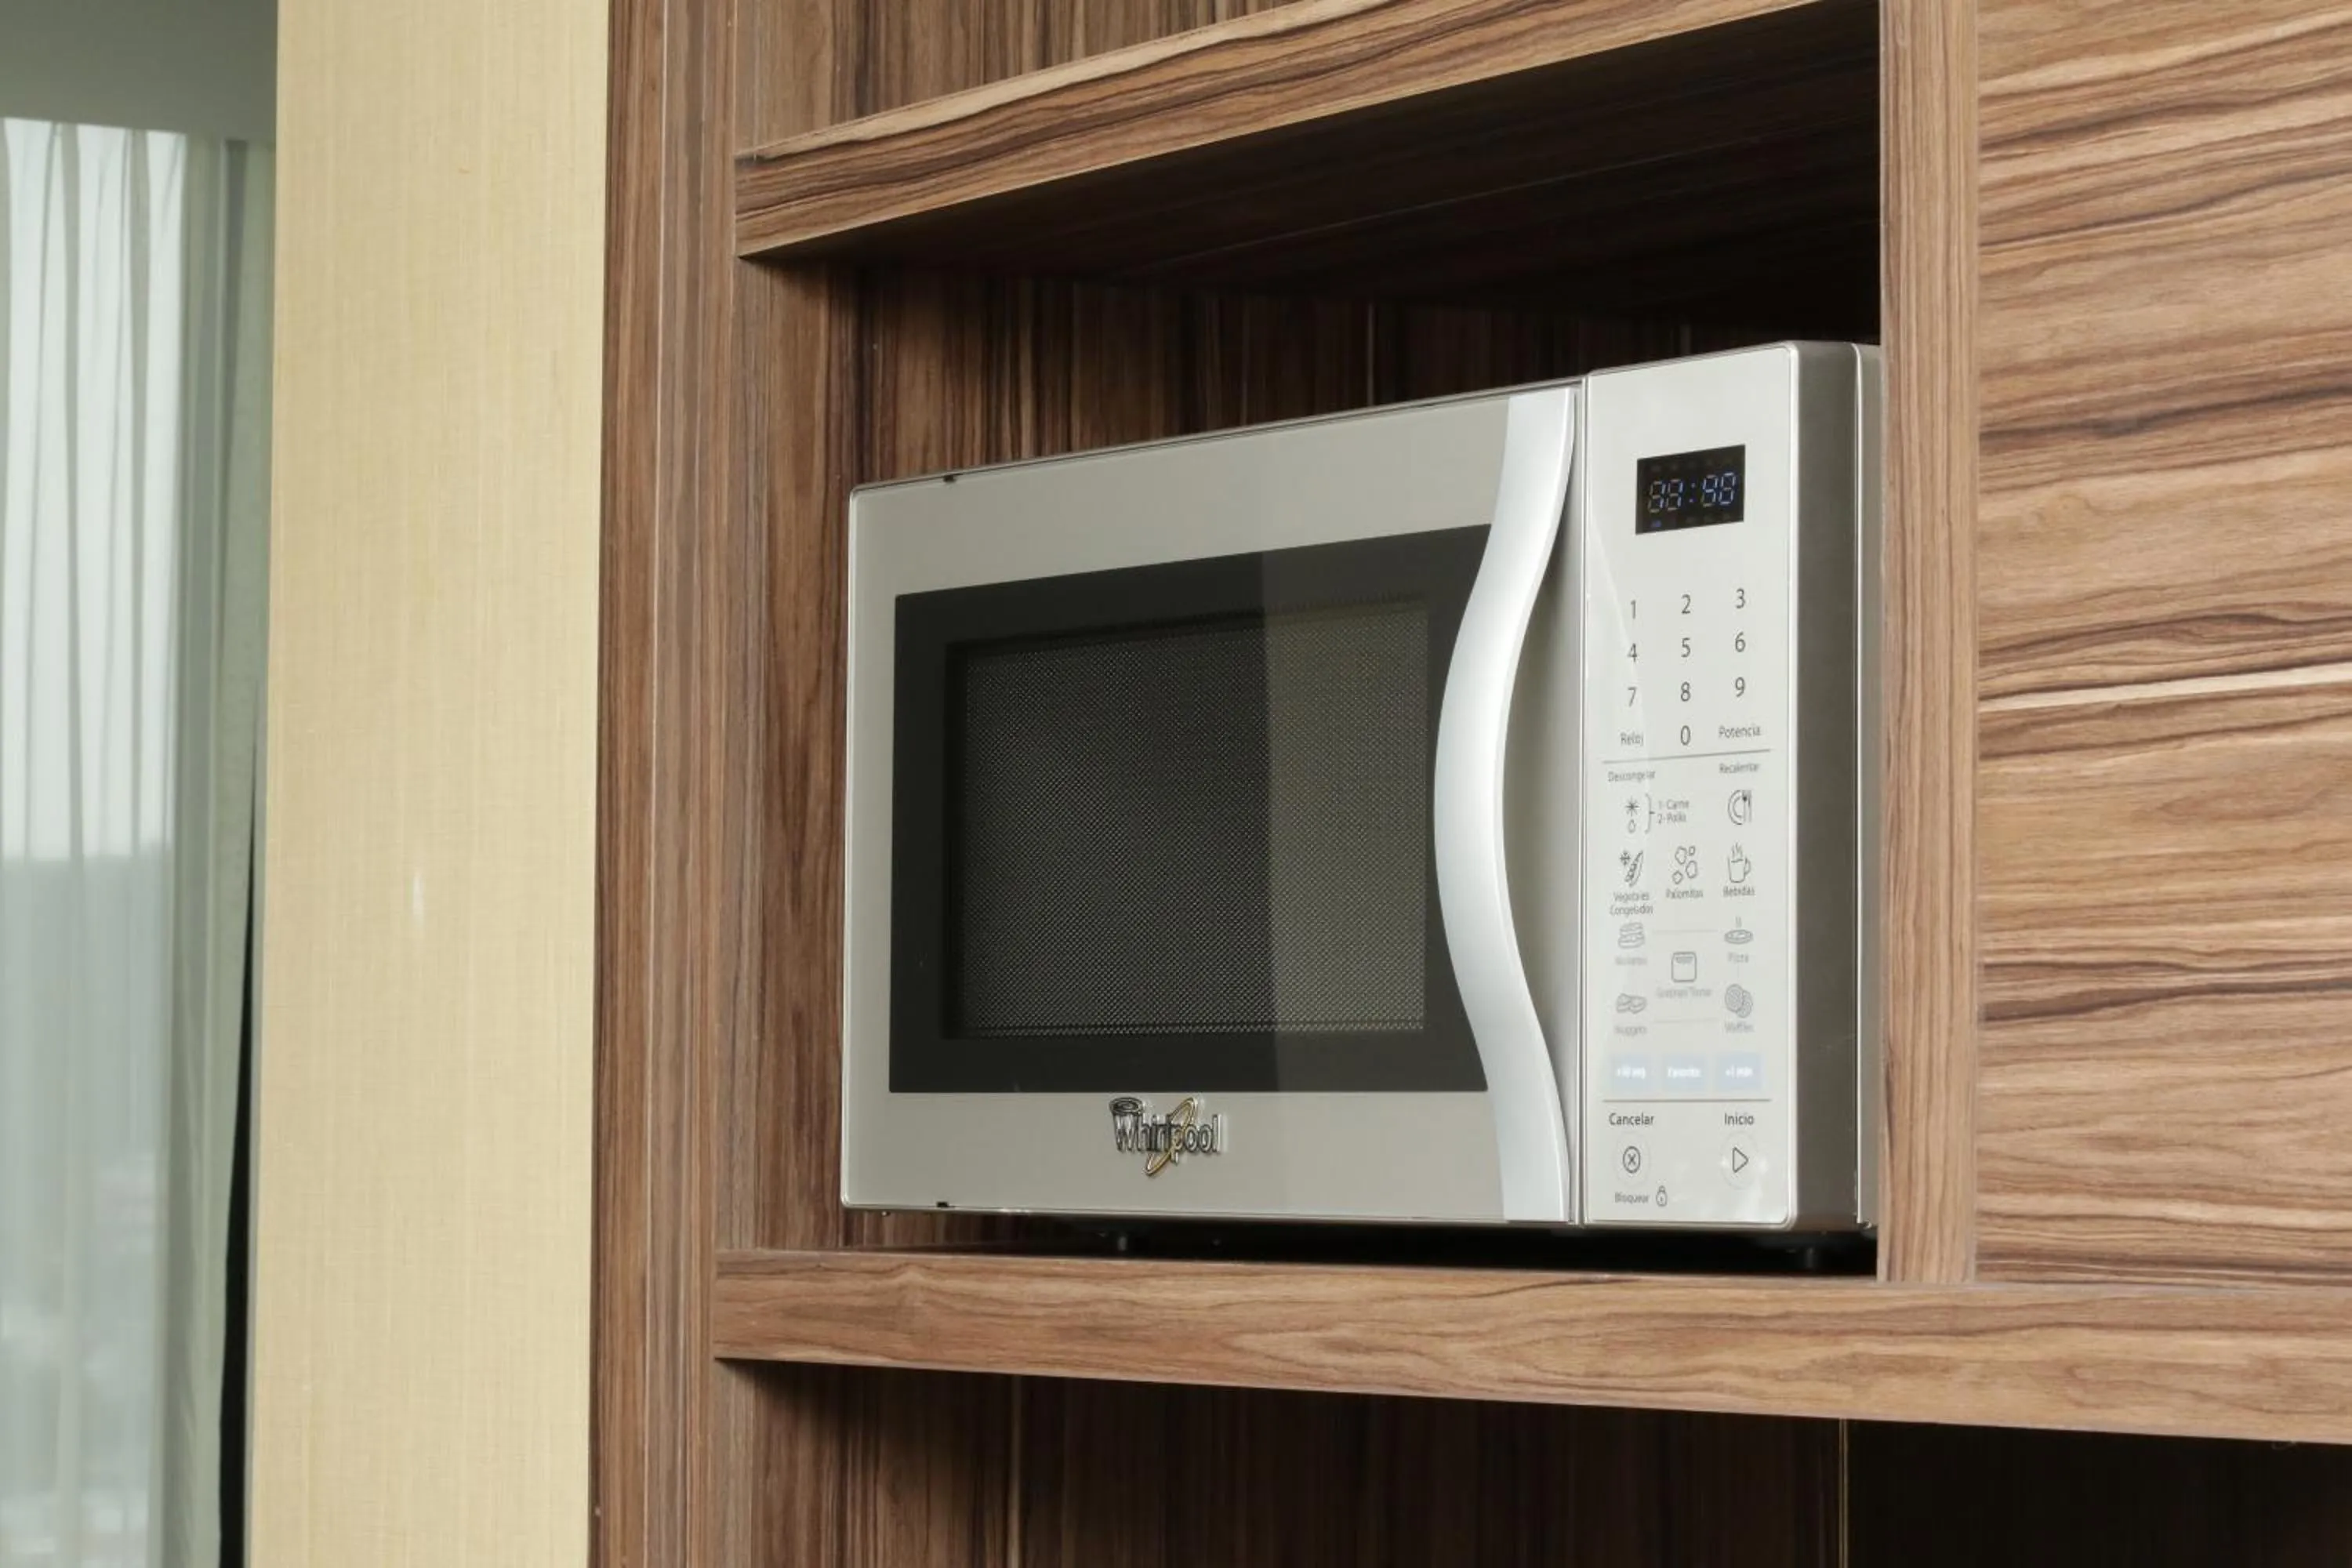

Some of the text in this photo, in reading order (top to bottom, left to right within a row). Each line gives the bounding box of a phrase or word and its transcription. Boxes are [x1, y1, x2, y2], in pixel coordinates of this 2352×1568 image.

[1681, 593, 1691, 615] 2
[1736, 588, 1746, 609] 3
[1630, 600, 1637, 619] 1
[1681, 637, 1691, 658] 5
[1735, 631, 1746, 652] 6
[1627, 643, 1638, 662] 4
[1627, 687, 1637, 707] 7
[1680, 681, 1691, 702] 8
[1735, 677, 1745, 697] 9
[1620, 731, 1644, 746] Reloj
[1680, 725, 1691, 746] 0
[1719, 724, 1761, 738] Potencia
[1608, 1112, 1654, 1126] Cancelar
[1725, 1112, 1755, 1125] Inicio
[1112, 1113, 1221, 1164] Whirlpool
